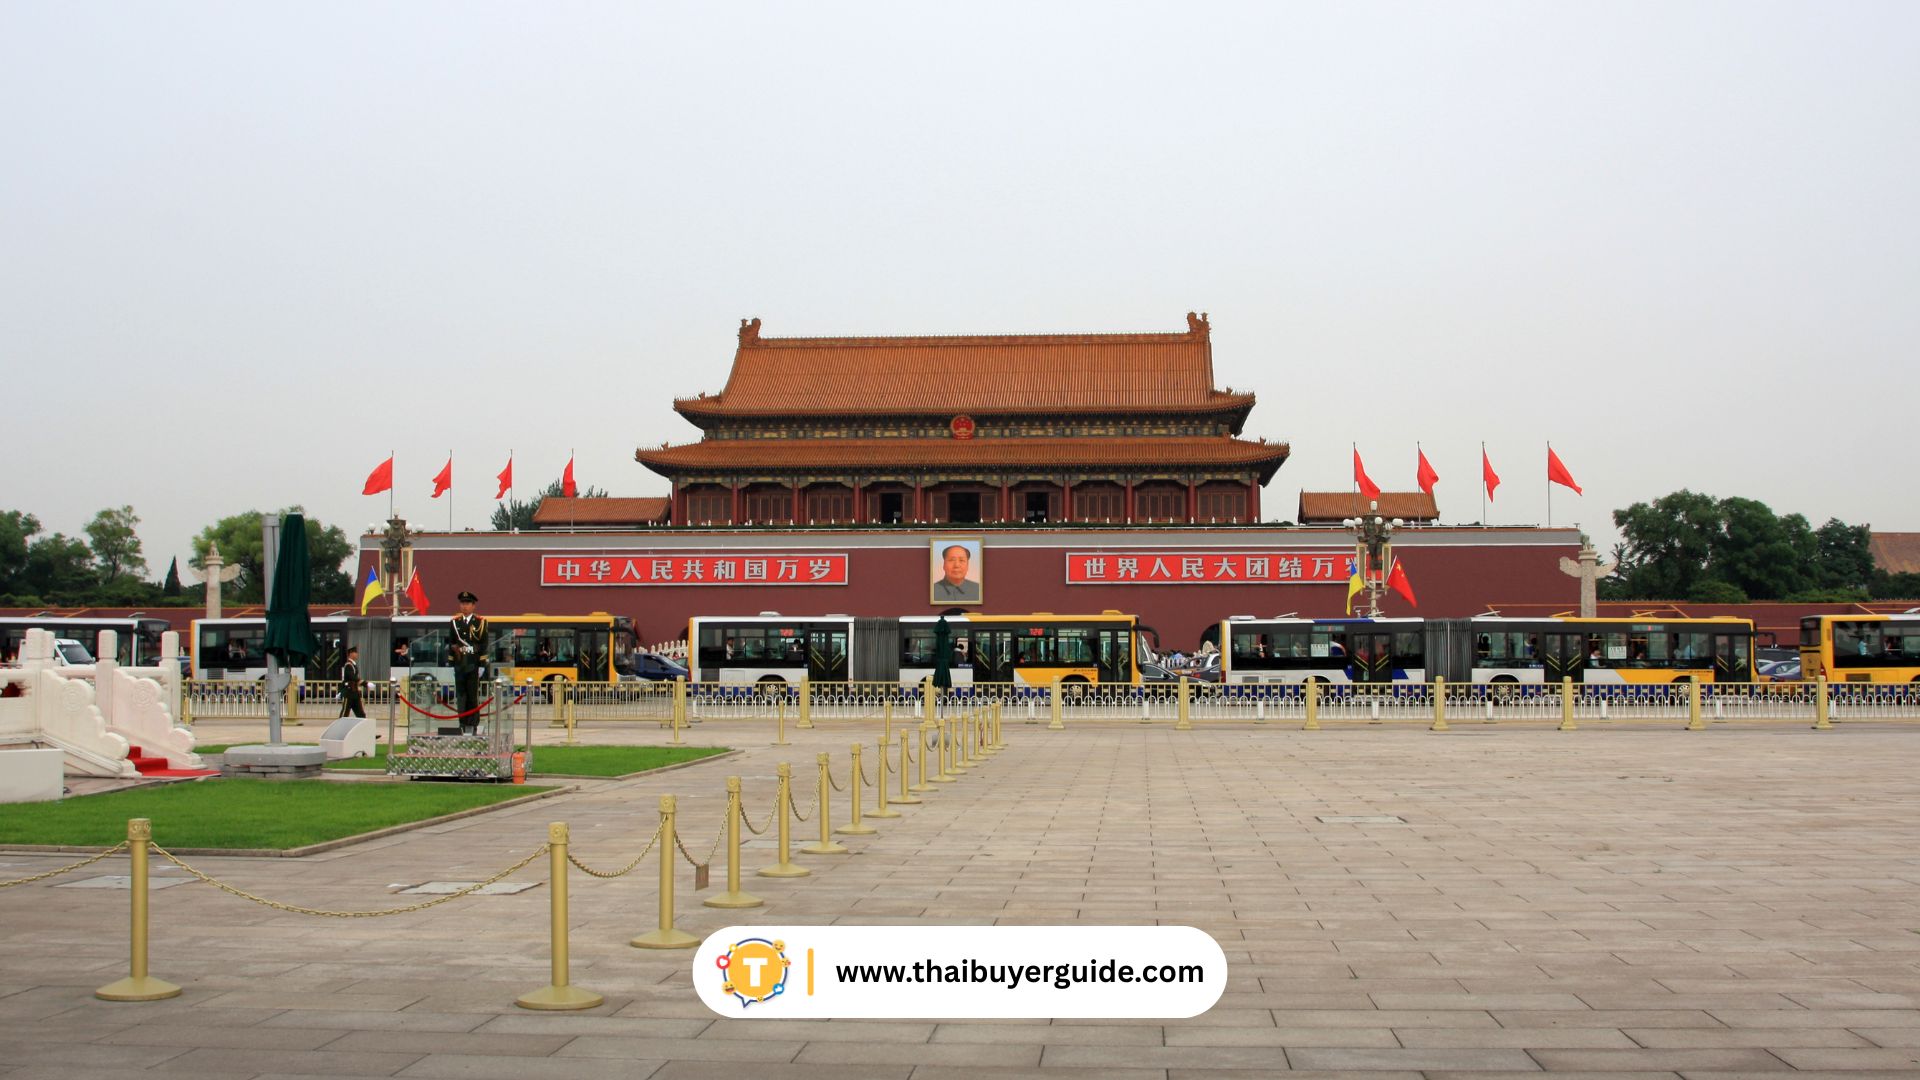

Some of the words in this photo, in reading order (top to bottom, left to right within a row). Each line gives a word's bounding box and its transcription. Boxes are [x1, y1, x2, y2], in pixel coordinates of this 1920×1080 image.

[557, 559, 831, 581] 中华人民共和国万岁
